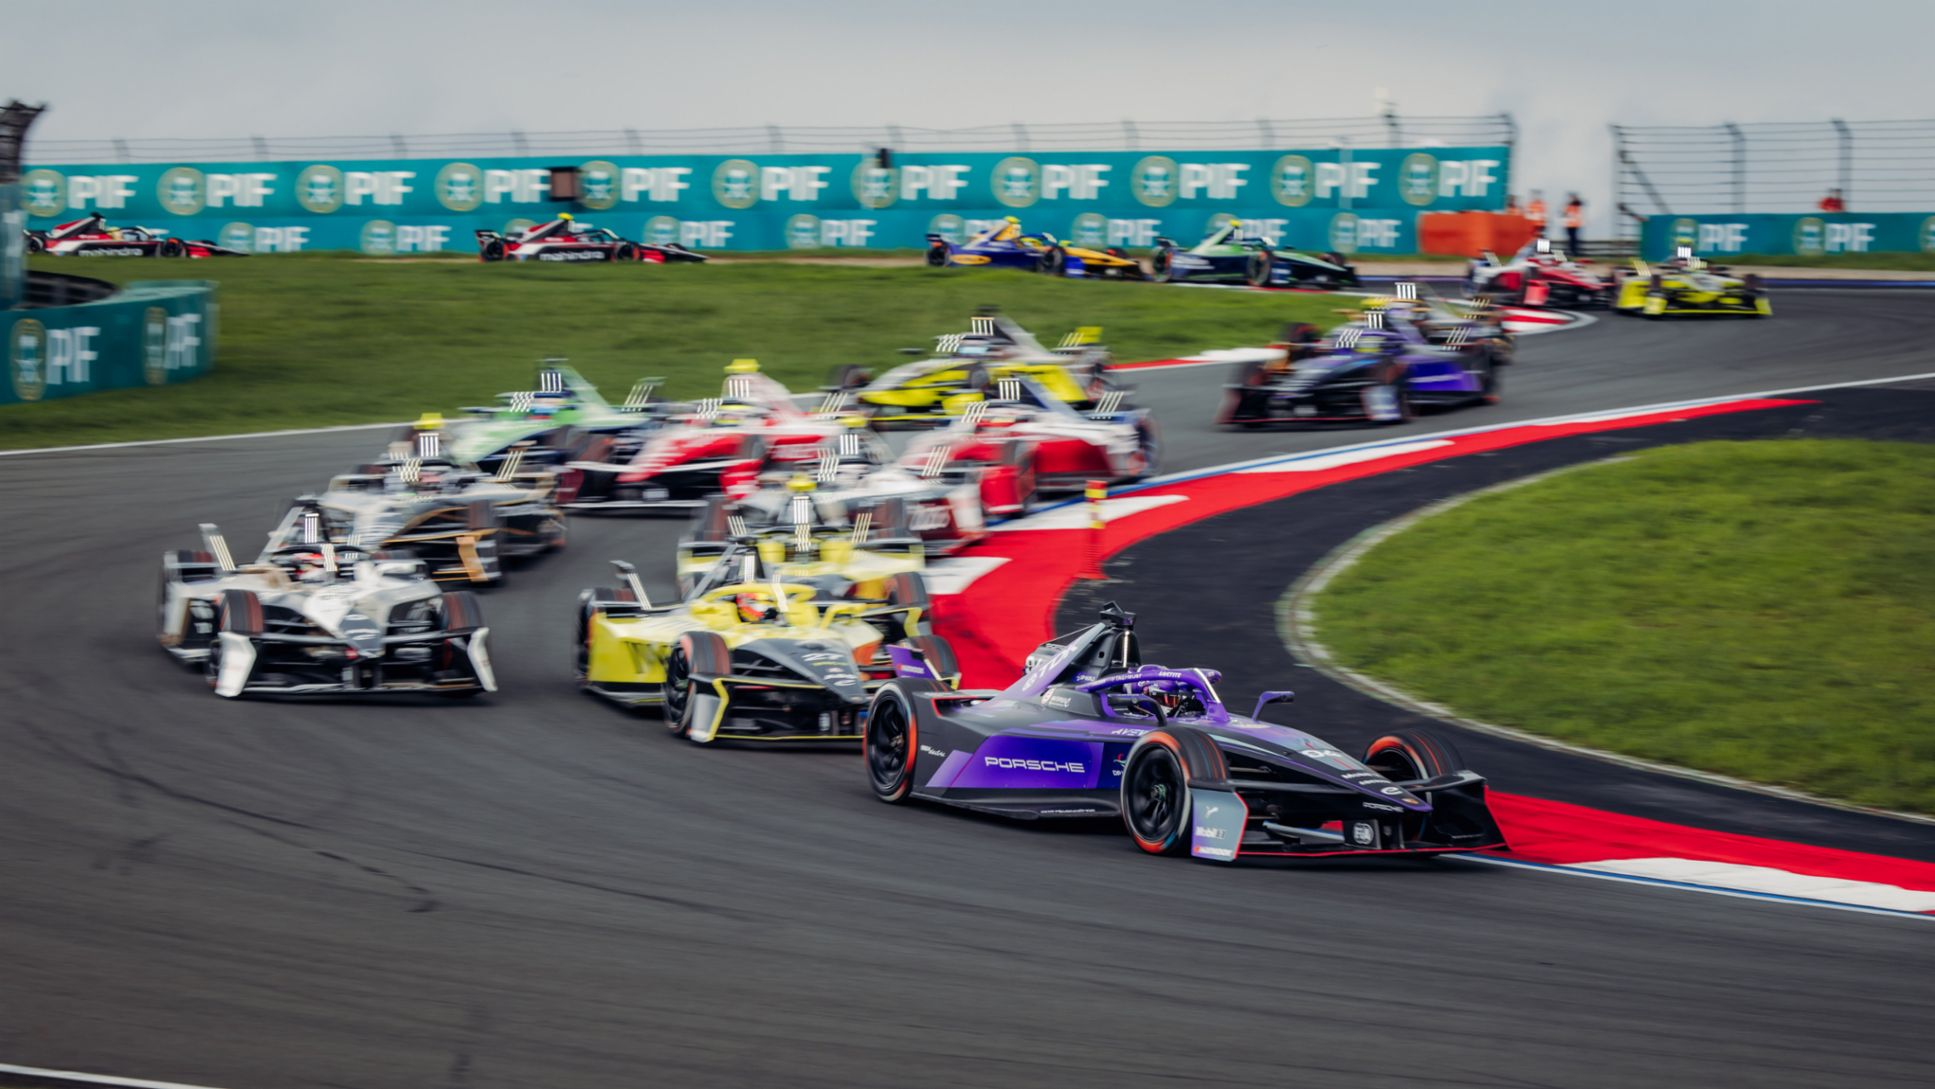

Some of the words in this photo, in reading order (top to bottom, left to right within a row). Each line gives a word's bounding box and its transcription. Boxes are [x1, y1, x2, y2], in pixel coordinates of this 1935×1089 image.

[67, 175, 139, 209] PIF
[206, 173, 277, 207] PIF
[344, 171, 416, 205] PIF
[484, 169, 551, 203] PIF
[621, 167, 693, 202] PIF
[760, 166, 832, 200] PIF
[901, 165, 971, 200] PIF
[1041, 164, 1112, 199] PIF
[1178, 163, 1250, 199] PIF
[1314, 162, 1381, 198] PIF
[1438, 160, 1500, 197] PIF
[254, 226, 311, 252] PIF
[396, 225, 451, 252] PIF
[678, 220, 735, 247] PIF
[820, 219, 878, 246] PIF
[1107, 218, 1162, 246] PIF
[1357, 218, 1402, 247] PIF
[1699, 223, 1749, 251] PIF
[1825, 223, 1876, 251] PIF
[45, 326, 101, 385] PIF
[1111, 728, 1149, 737] AVEV
[984, 756, 1086, 773] PORSCHE
